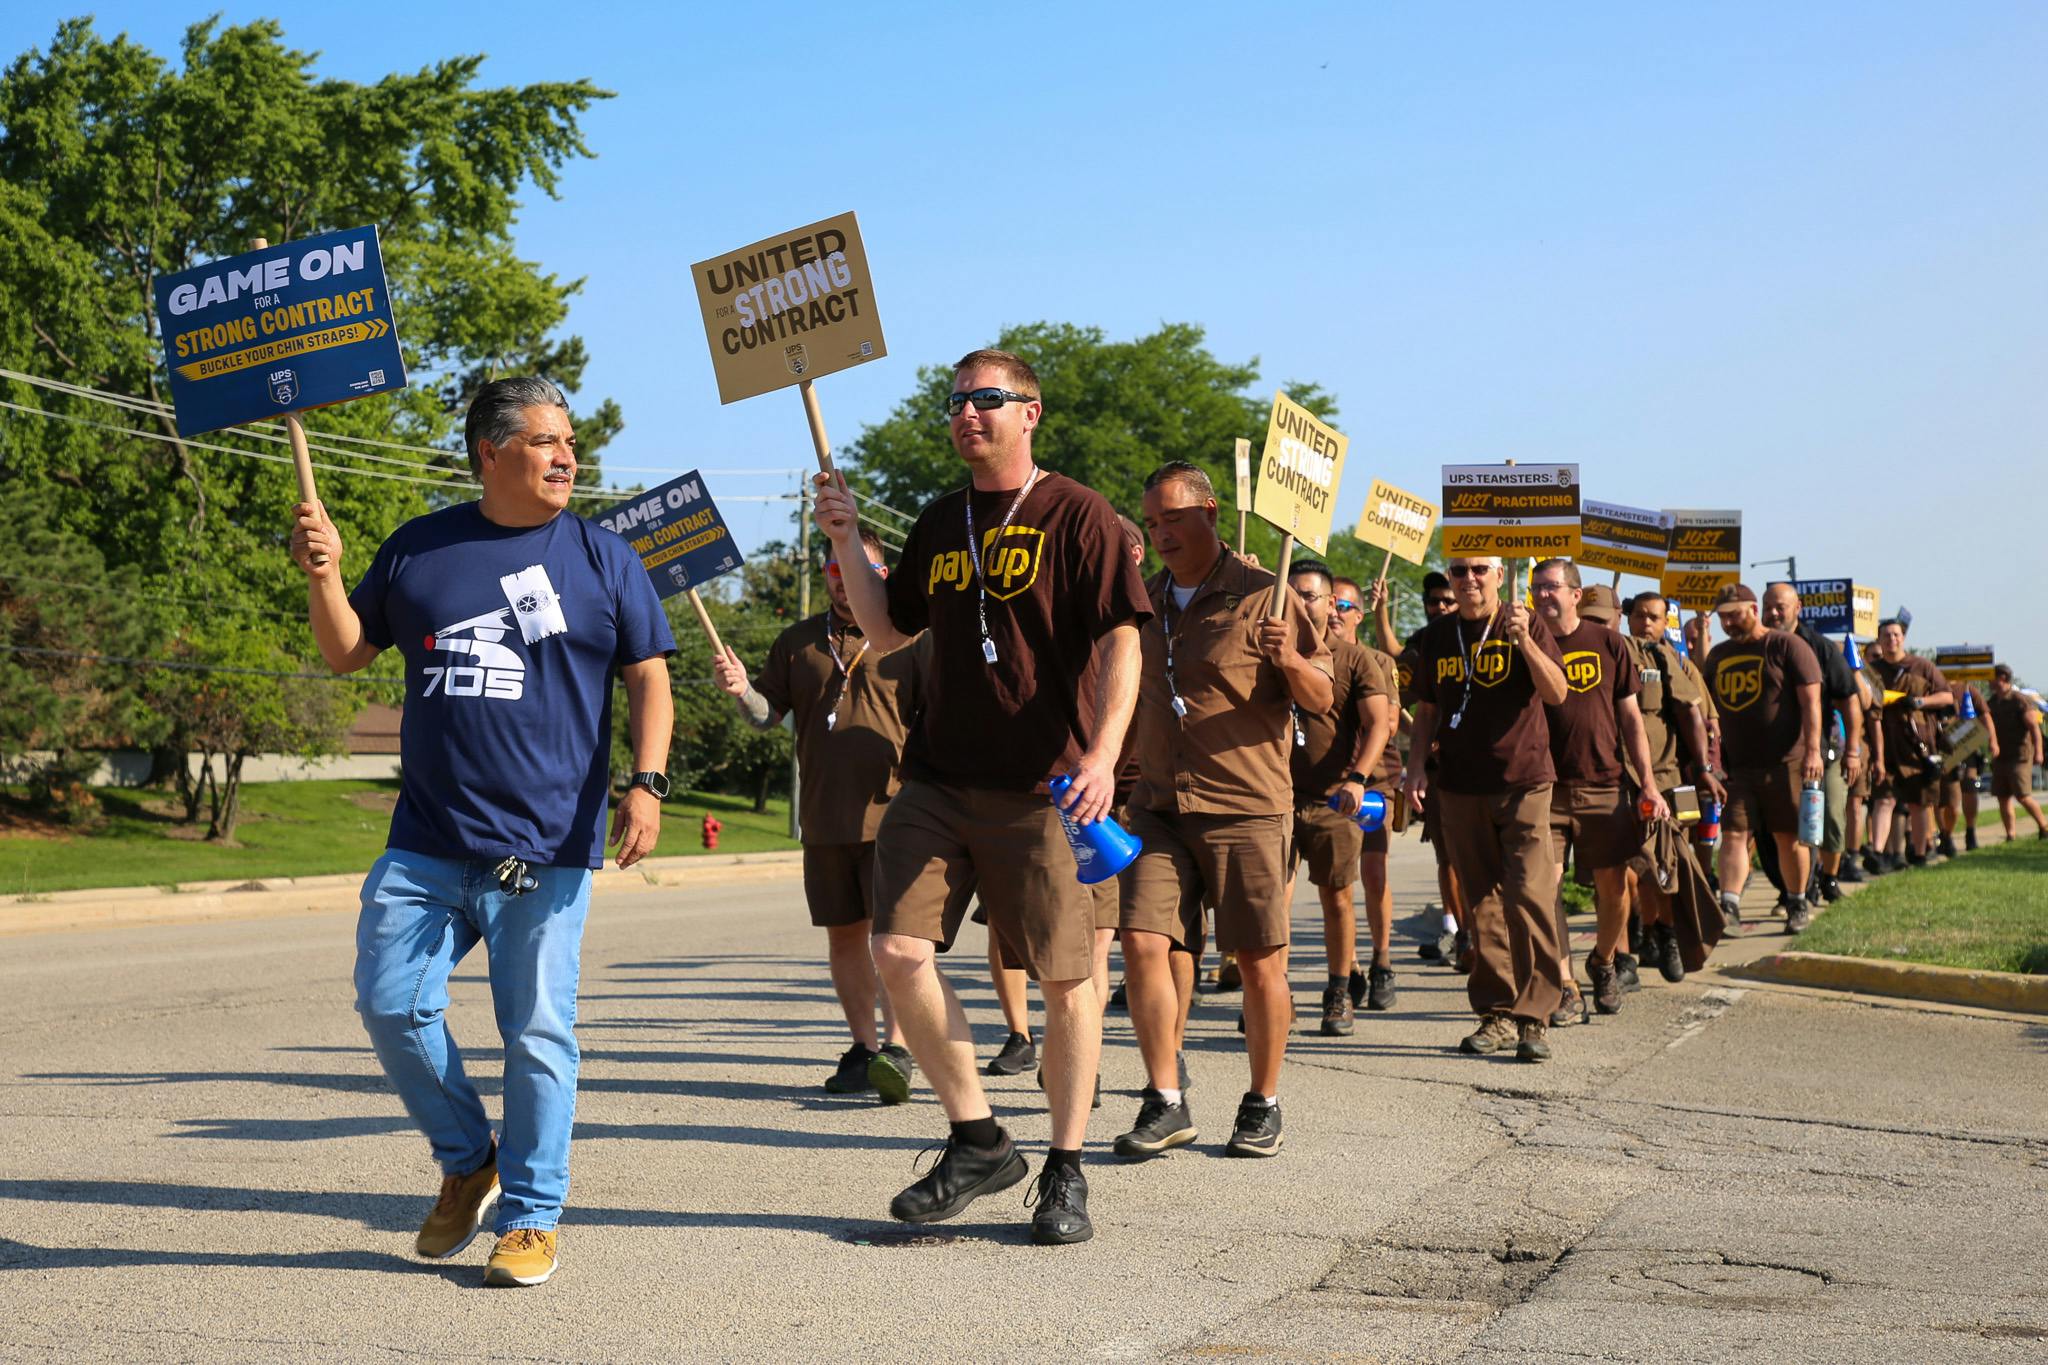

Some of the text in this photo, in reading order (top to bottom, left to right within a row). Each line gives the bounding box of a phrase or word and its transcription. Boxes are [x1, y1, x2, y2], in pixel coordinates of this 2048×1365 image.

[707, 229, 847, 295] UNITED
[169, 240, 365, 315] GAME ON
[735, 251, 852, 328] STRONG
[255, 293, 281, 310] FOR A
[715, 304, 735, 319] FOR A
[175, 288, 375, 358] STRONG CONTRACT
[722, 288, 859, 355] CONTRACT
[200, 327, 359, 375] BUCKLE YOUR CHIN STRAPS!
[785, 344, 802, 354] UPS
[270, 369, 292, 381] UPS
[1276, 403, 1339, 462] UNITED
[1279, 436, 1334, 488] STRONG
[1266, 456, 1329, 513] CONTRACT
[1449, 473, 1553, 484] UPS TEAMSTERS:
[666, 479, 701, 509] ON
[1376, 485, 1432, 518] UNITED
[1451, 493, 1573, 508] JUST PRACTICING
[1586, 505, 1603, 514] UPS
[630, 507, 714, 555] ONG CONTRACT
[1367, 510, 1425, 544] CONTRACT
[1452, 534, 1571, 548] JUST CONTRACT
[1678, 530, 1725, 545] JUST
[928, 547, 1030, 595] pay up
[1606, 554, 1659, 572] CONTRACT
[1678, 575, 1722, 589] JUST
[1797, 581, 1847, 595] ITED
[1798, 605, 1847, 618] TRACT
[1800, 592, 1847, 607] RONG
[423, 667, 525, 701] 705
[1437, 654, 1504, 684] pay up
[1566, 663, 1596, 685] up
[1719, 671, 1759, 703] ups
